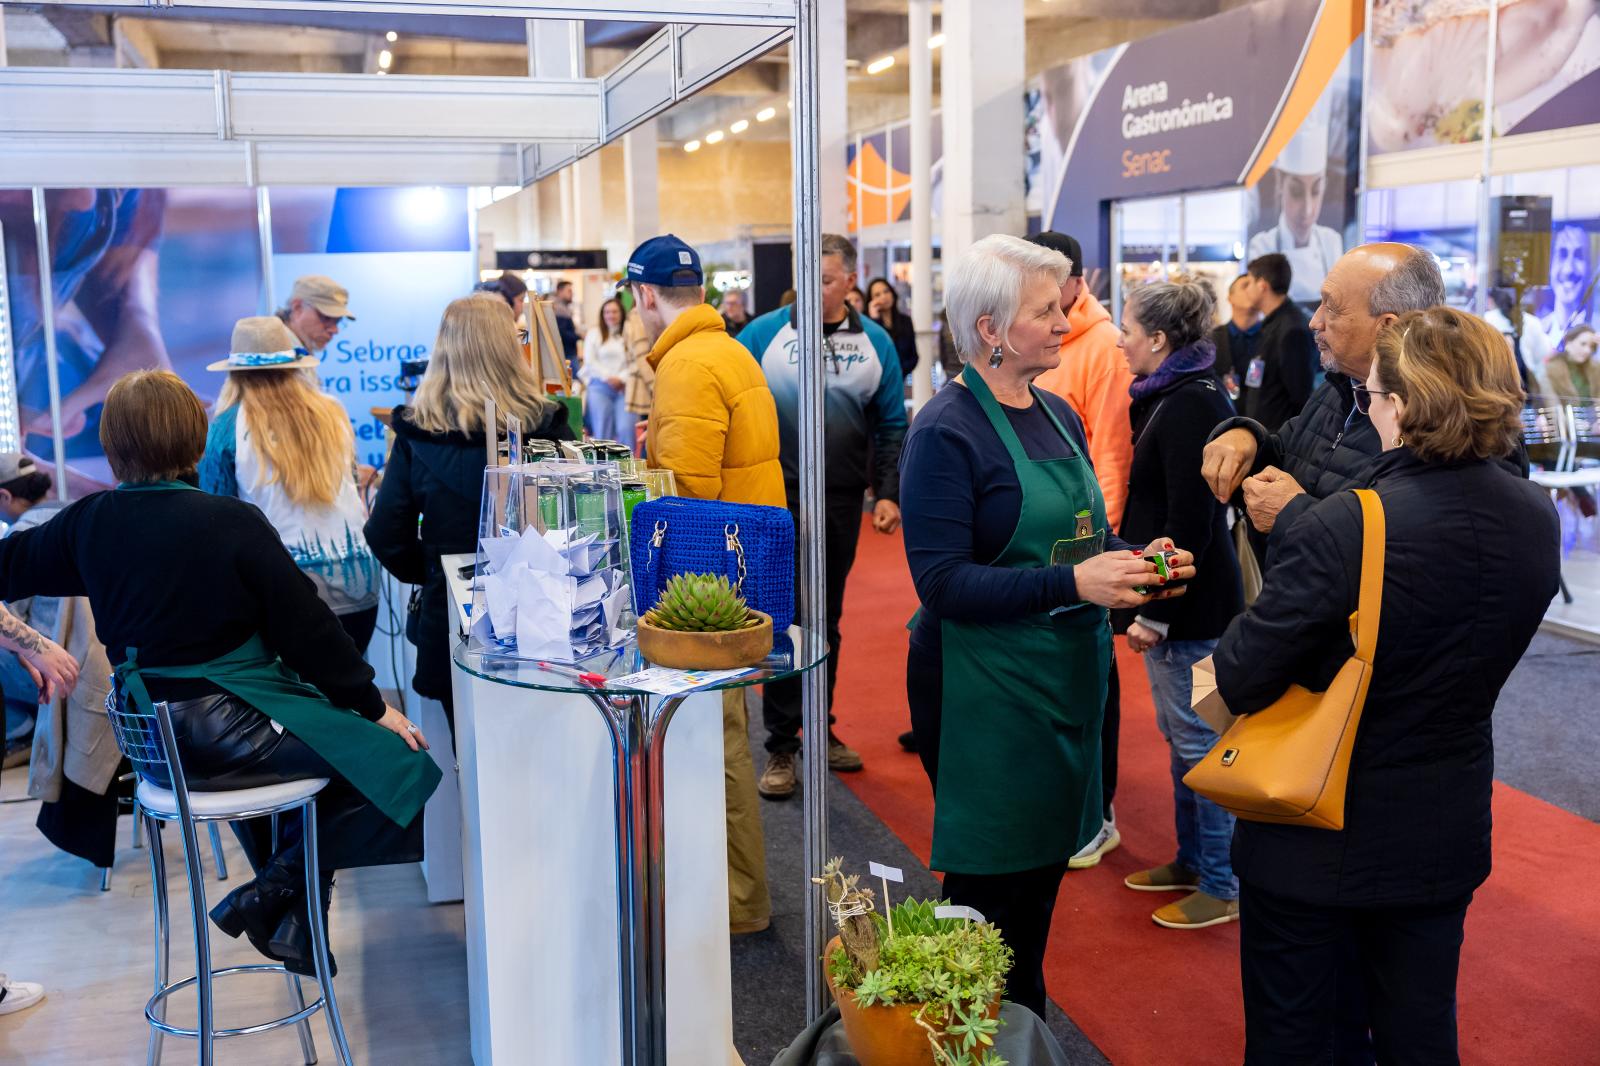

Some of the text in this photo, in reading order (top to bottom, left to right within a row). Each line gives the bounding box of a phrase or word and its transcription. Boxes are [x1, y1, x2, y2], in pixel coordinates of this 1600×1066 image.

[1122, 81, 1168, 112] Arena
[1122, 92, 1233, 139] Gastronômica
[1121, 149, 1171, 177] Senac
[336, 339, 427, 363] Sebrae
